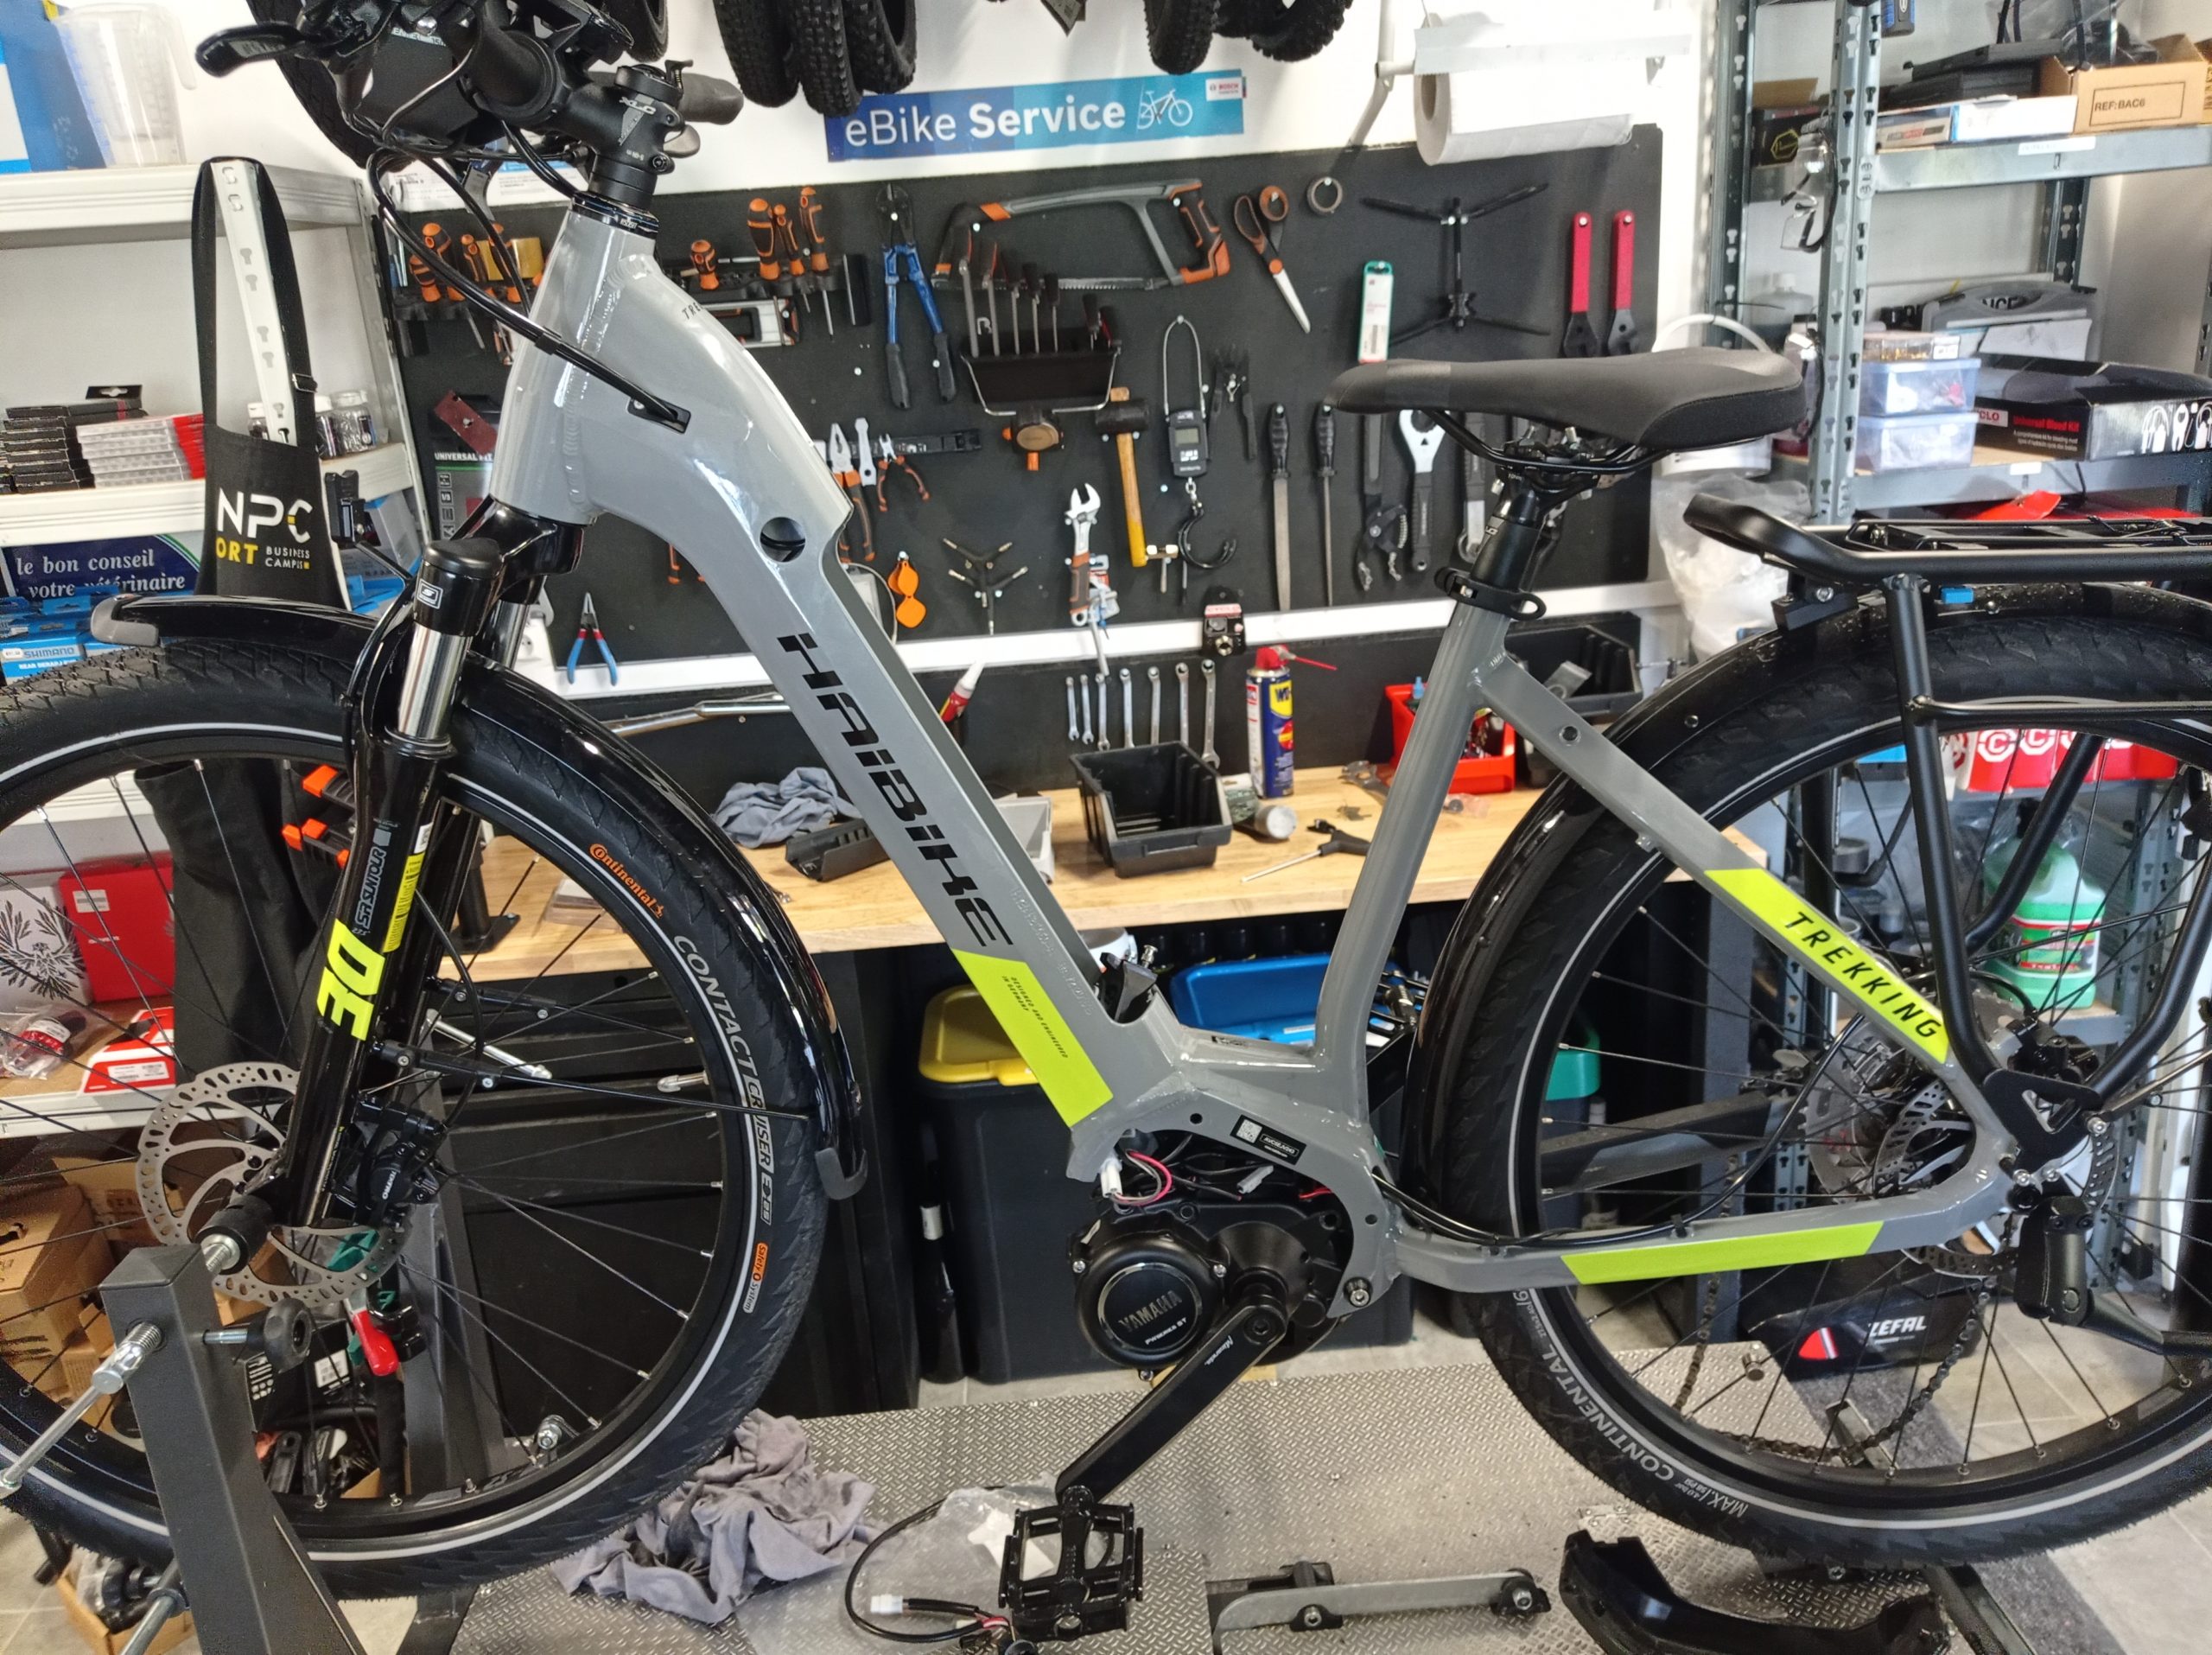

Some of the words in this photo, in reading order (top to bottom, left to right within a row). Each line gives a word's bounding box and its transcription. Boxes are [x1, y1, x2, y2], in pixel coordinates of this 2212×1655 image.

[619, 96, 657, 115] XLC
[845, 107, 957, 147] eBike
[969, 94, 1127, 138] Service
[434, 452, 477, 461] UNIVERSAL
[217, 487, 313, 544] NPC
[16, 557, 34, 576] le
[43, 556, 79, 574] bon
[88, 549, 155, 571] conseil
[215, 537, 258, 565] ORT
[29, 582, 76, 598] votre
[23, 646, 75, 659] SHIMANO
[589, 843, 658, 910] Continental
[1784, 912, 1942, 1038] TREKKING
[673, 935, 759, 1077] CONTACT
[1119, 1290, 1183, 1333] YAMAHA
[1541, 1343, 1675, 1482] CONTINENTAL
